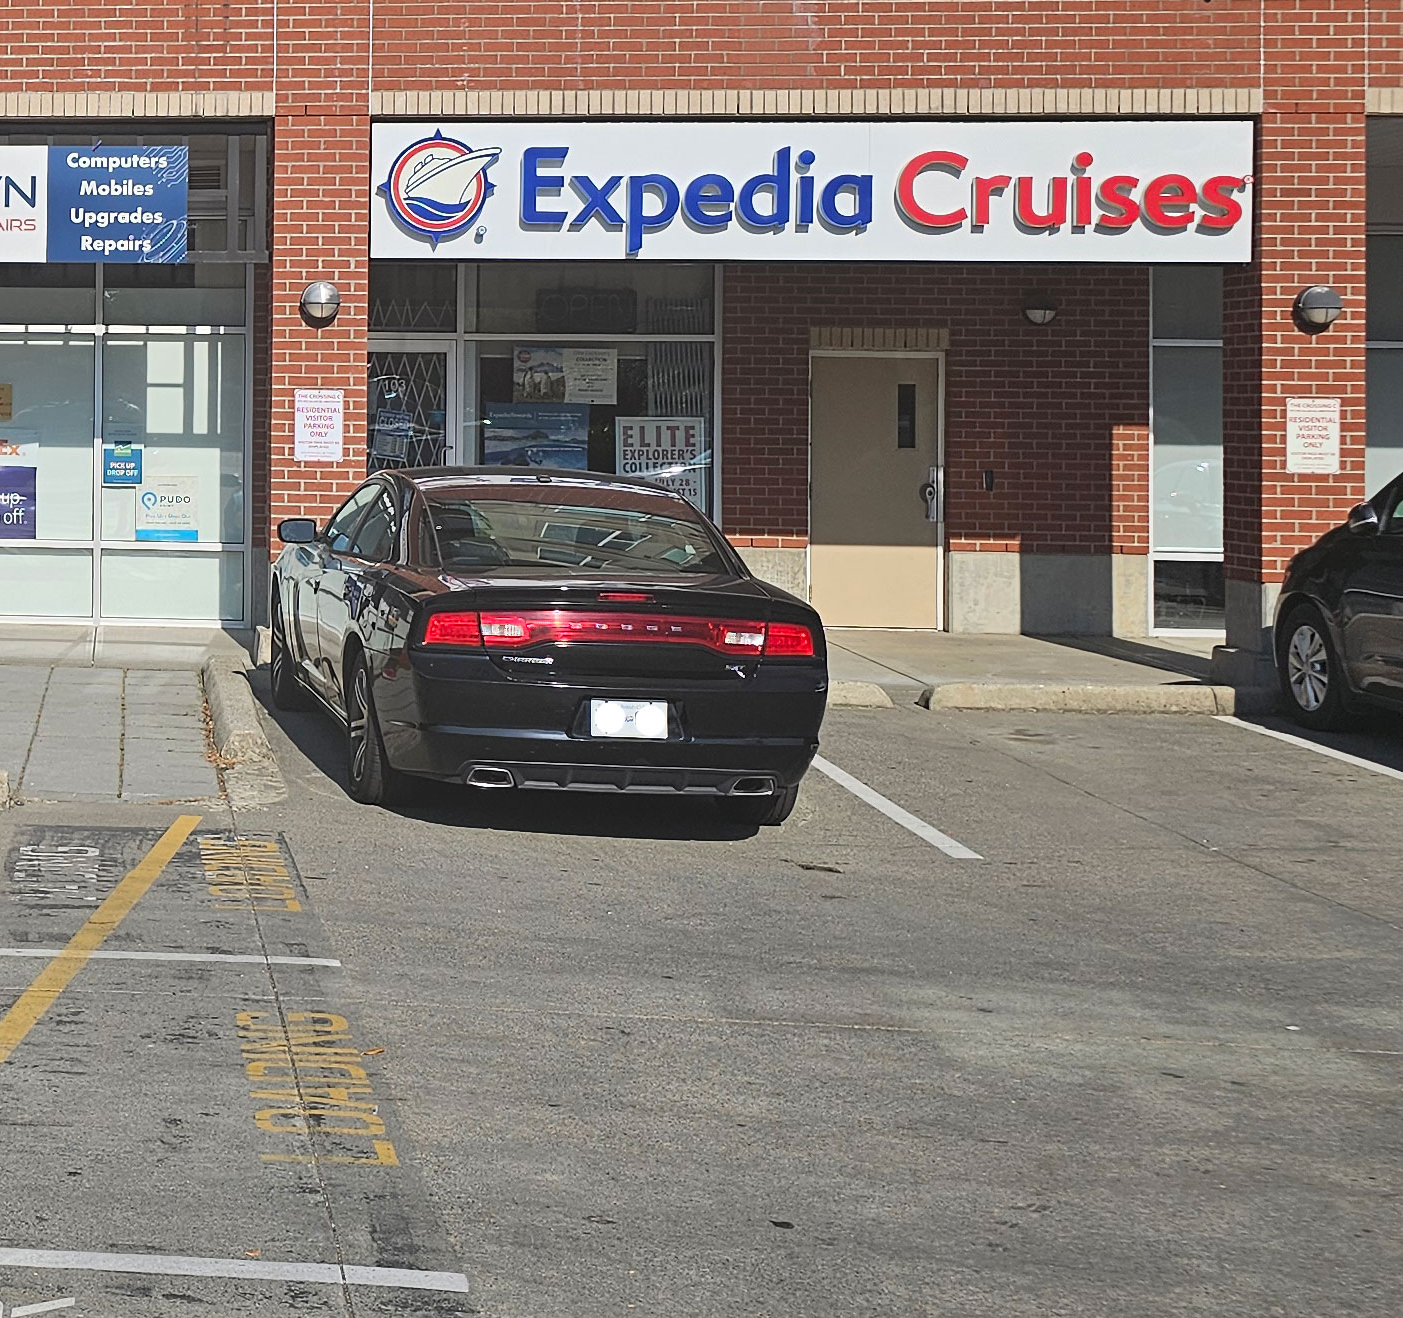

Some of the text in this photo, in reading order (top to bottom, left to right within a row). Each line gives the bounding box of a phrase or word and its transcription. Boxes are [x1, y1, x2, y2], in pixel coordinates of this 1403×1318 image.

[66, 152, 168, 173] Computers
[79, 179, 154, 196] Mobiles
[519, 145, 1244, 256] Expedia Cruises
[70, 206, 163, 228] Upgrades
[80, 235, 152, 255] Repairs
[384, 379, 406, 391] 103
[622, 425, 696, 448] ELITE
[622, 448, 697, 460] EXPLORER'S
[623, 462, 696, 474] COLLEN
[679, 479, 690, 487] 28
[160, 495, 191, 503] PUDO
[235, 1010, 401, 1168] LOADING
